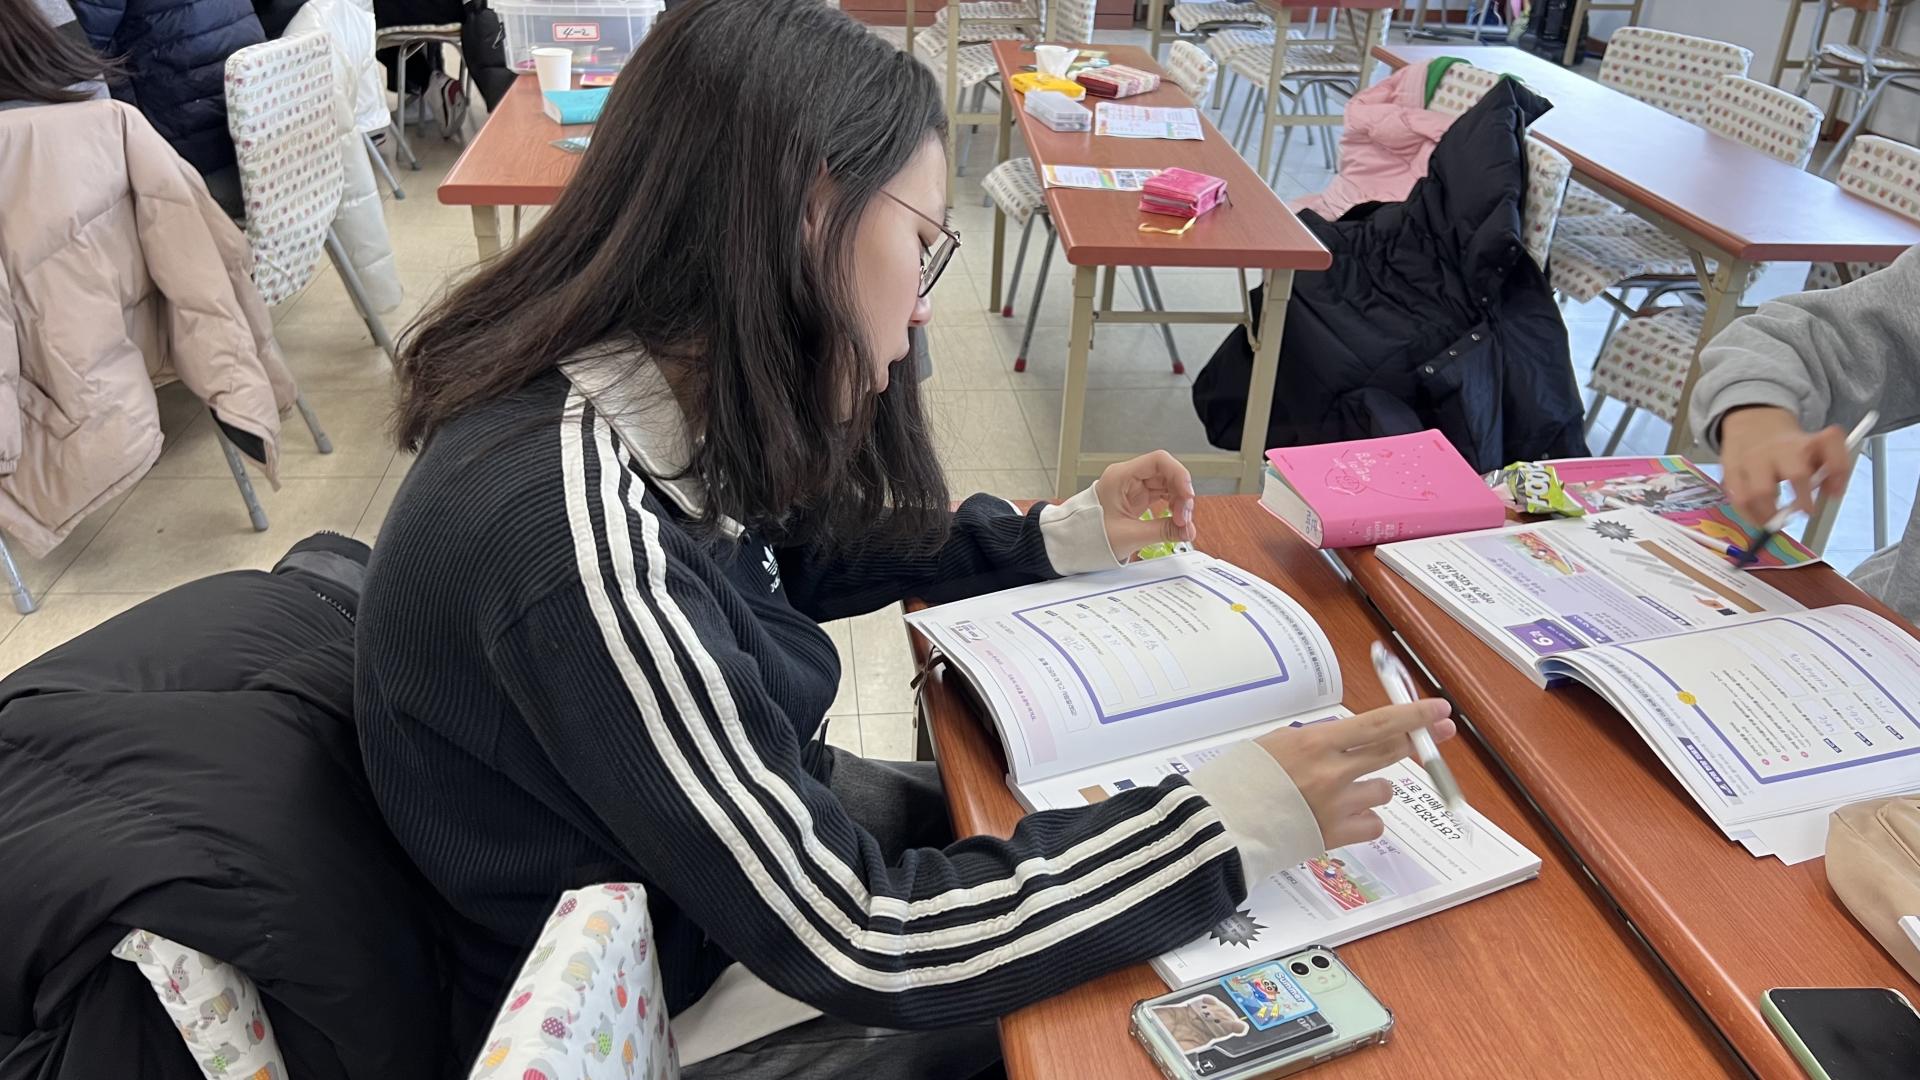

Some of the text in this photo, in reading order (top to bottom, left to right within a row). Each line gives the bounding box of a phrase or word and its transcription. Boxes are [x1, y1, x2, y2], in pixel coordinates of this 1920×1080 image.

[563, 26, 590, 40] 4-2
[1436, 561, 1473, 586] 되었나요?
[1444, 580, 1466, 592] 인해
[1469, 586, 1495, 604] 어떻게
[1529, 630, 1554, 646] 6과
[1399, 777, 1465, 834] 죄로 인해 우리는
[1411, 802, 1461, 840] 되었나요?
[1274, 971, 1306, 1003] Summer
